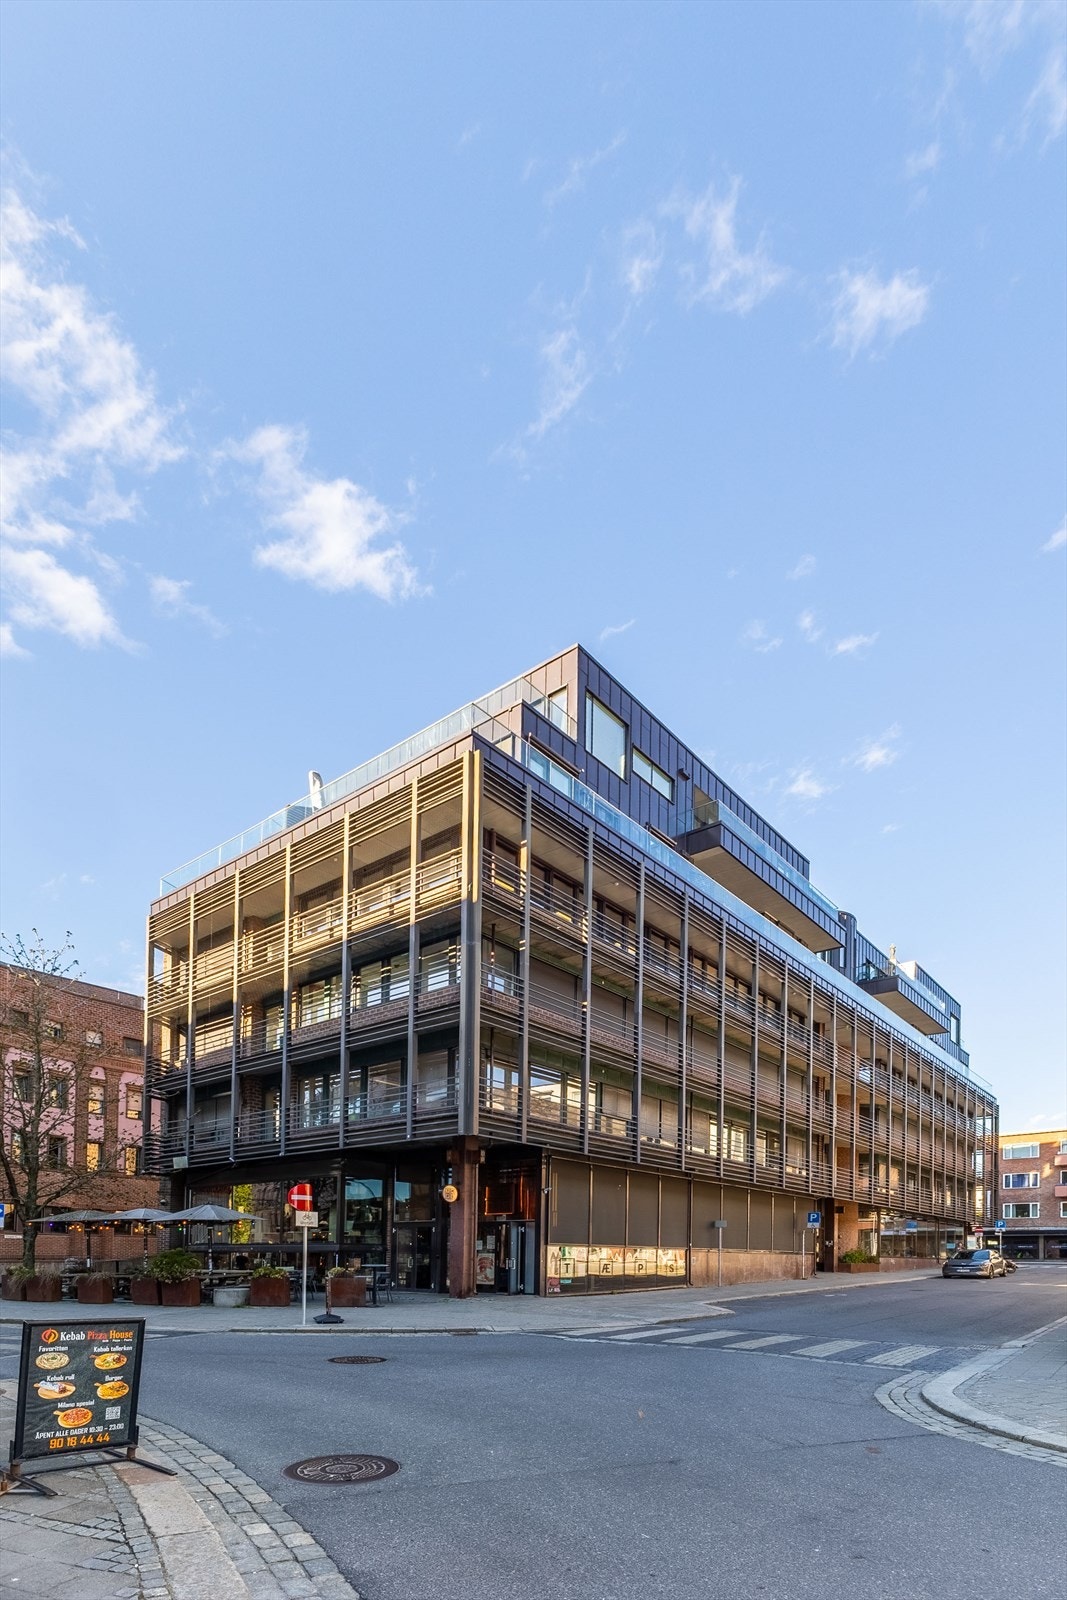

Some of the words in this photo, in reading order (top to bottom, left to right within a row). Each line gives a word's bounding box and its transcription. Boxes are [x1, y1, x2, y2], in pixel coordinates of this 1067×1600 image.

[60, 1331, 86, 1341] Kebab
[87, 1331, 108, 1340] Pizza
[110, 1330, 133, 1339] House
[49, 1439, 64, 1449] 90
[80, 1435, 94, 1445] 44
[96, 1433, 110, 1443] 44
